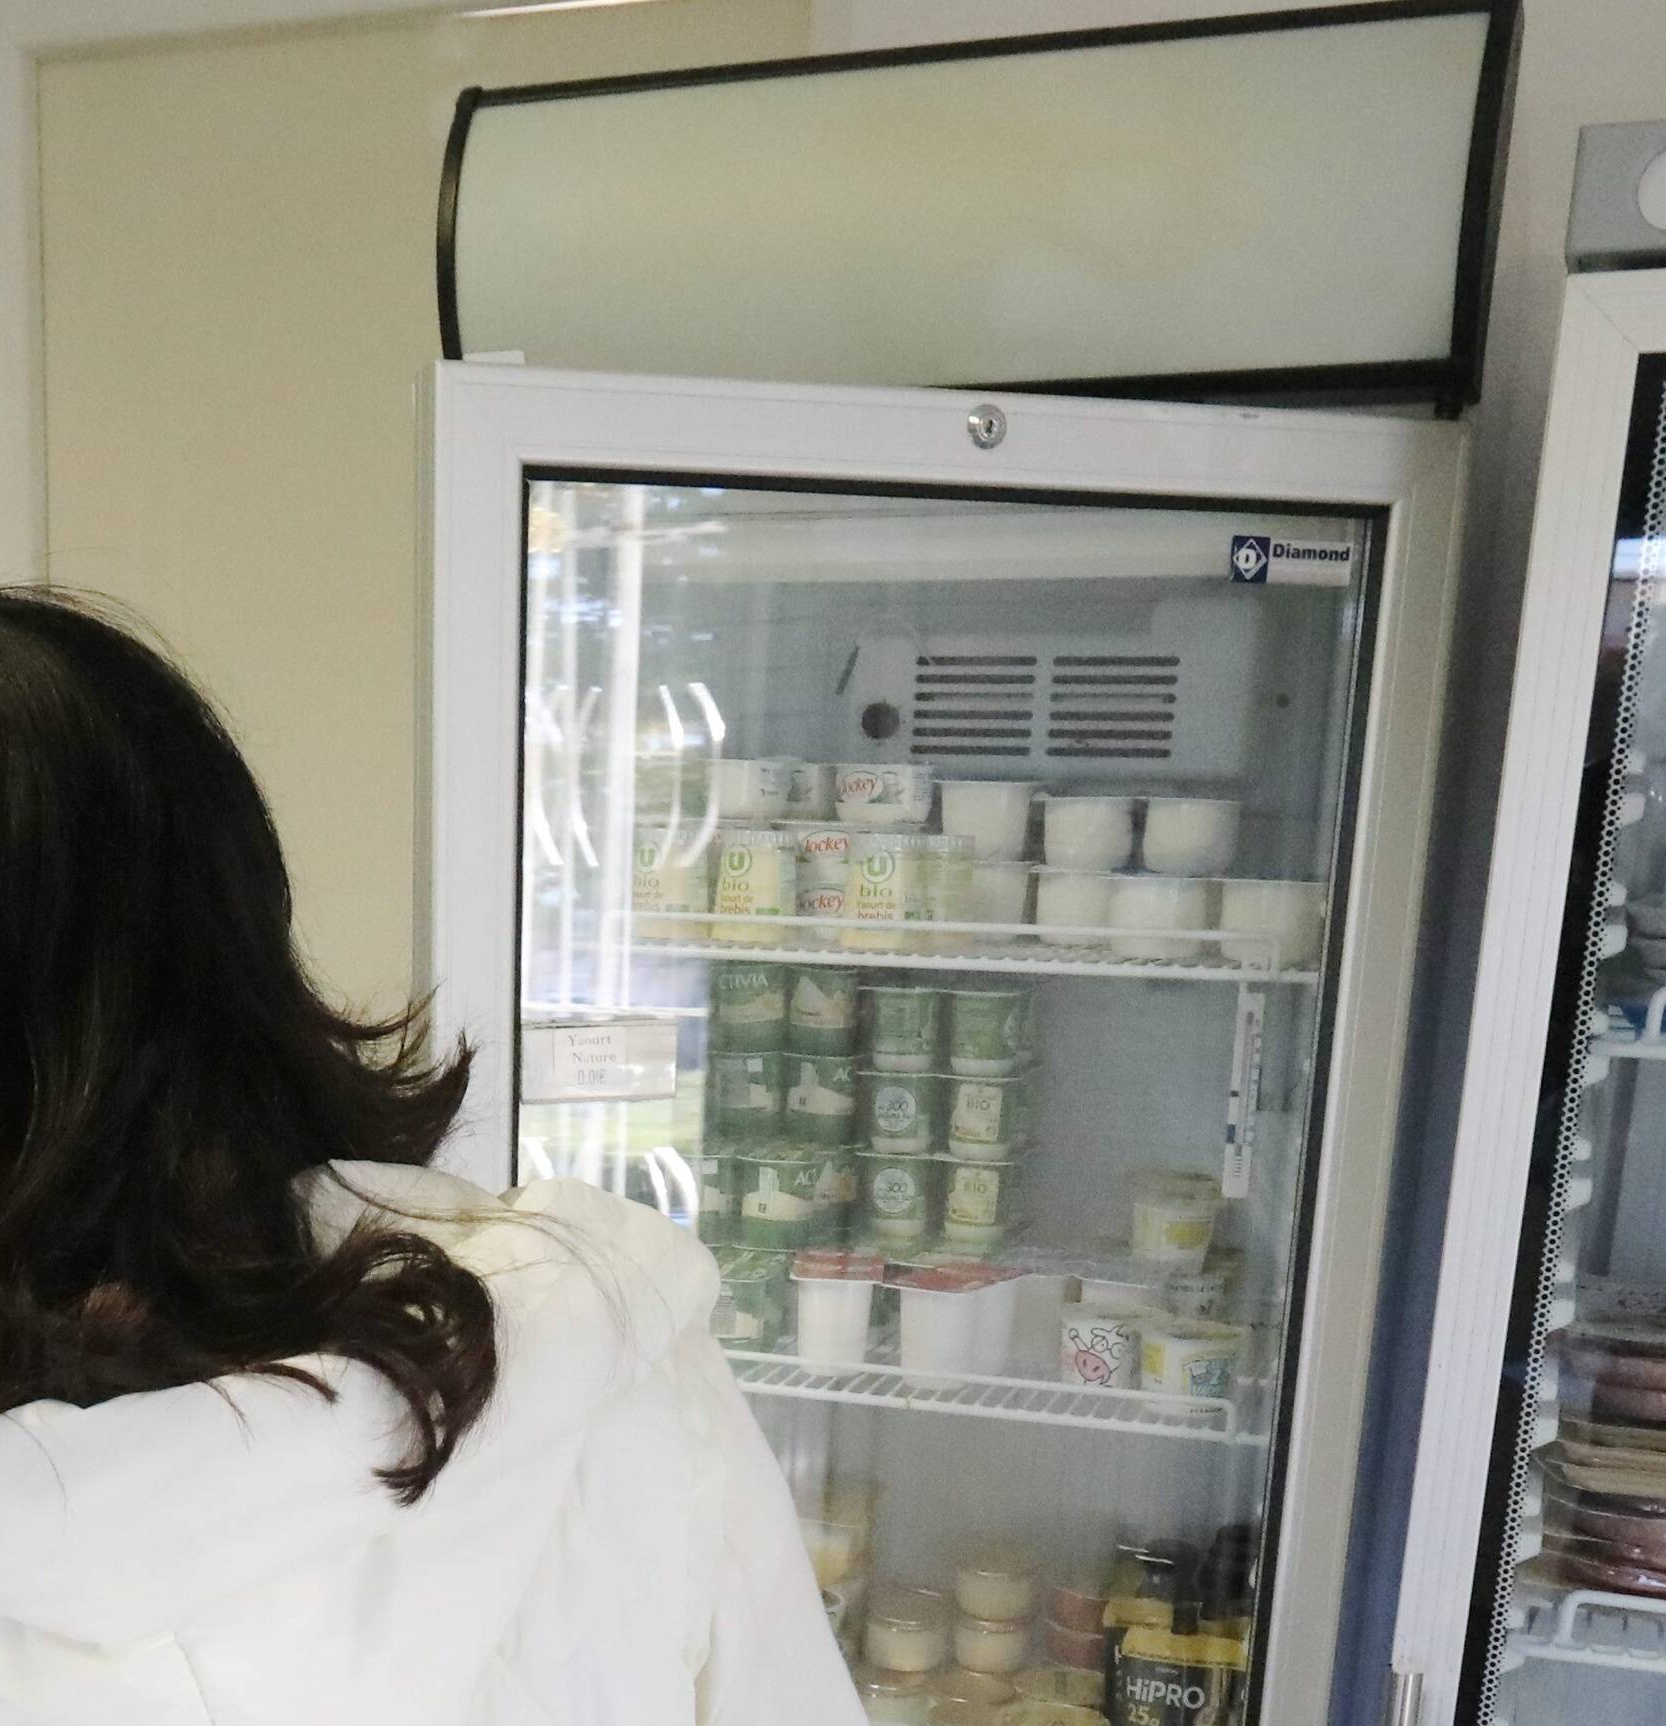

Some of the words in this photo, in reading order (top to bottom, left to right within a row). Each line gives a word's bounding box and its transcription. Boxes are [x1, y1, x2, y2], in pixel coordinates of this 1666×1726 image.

[1272, 543, 1351, 561] Diamond
[721, 877, 750, 891] bio
[859, 884, 893, 897] bio
[1126, 1676, 1206, 1710] HiPRO
